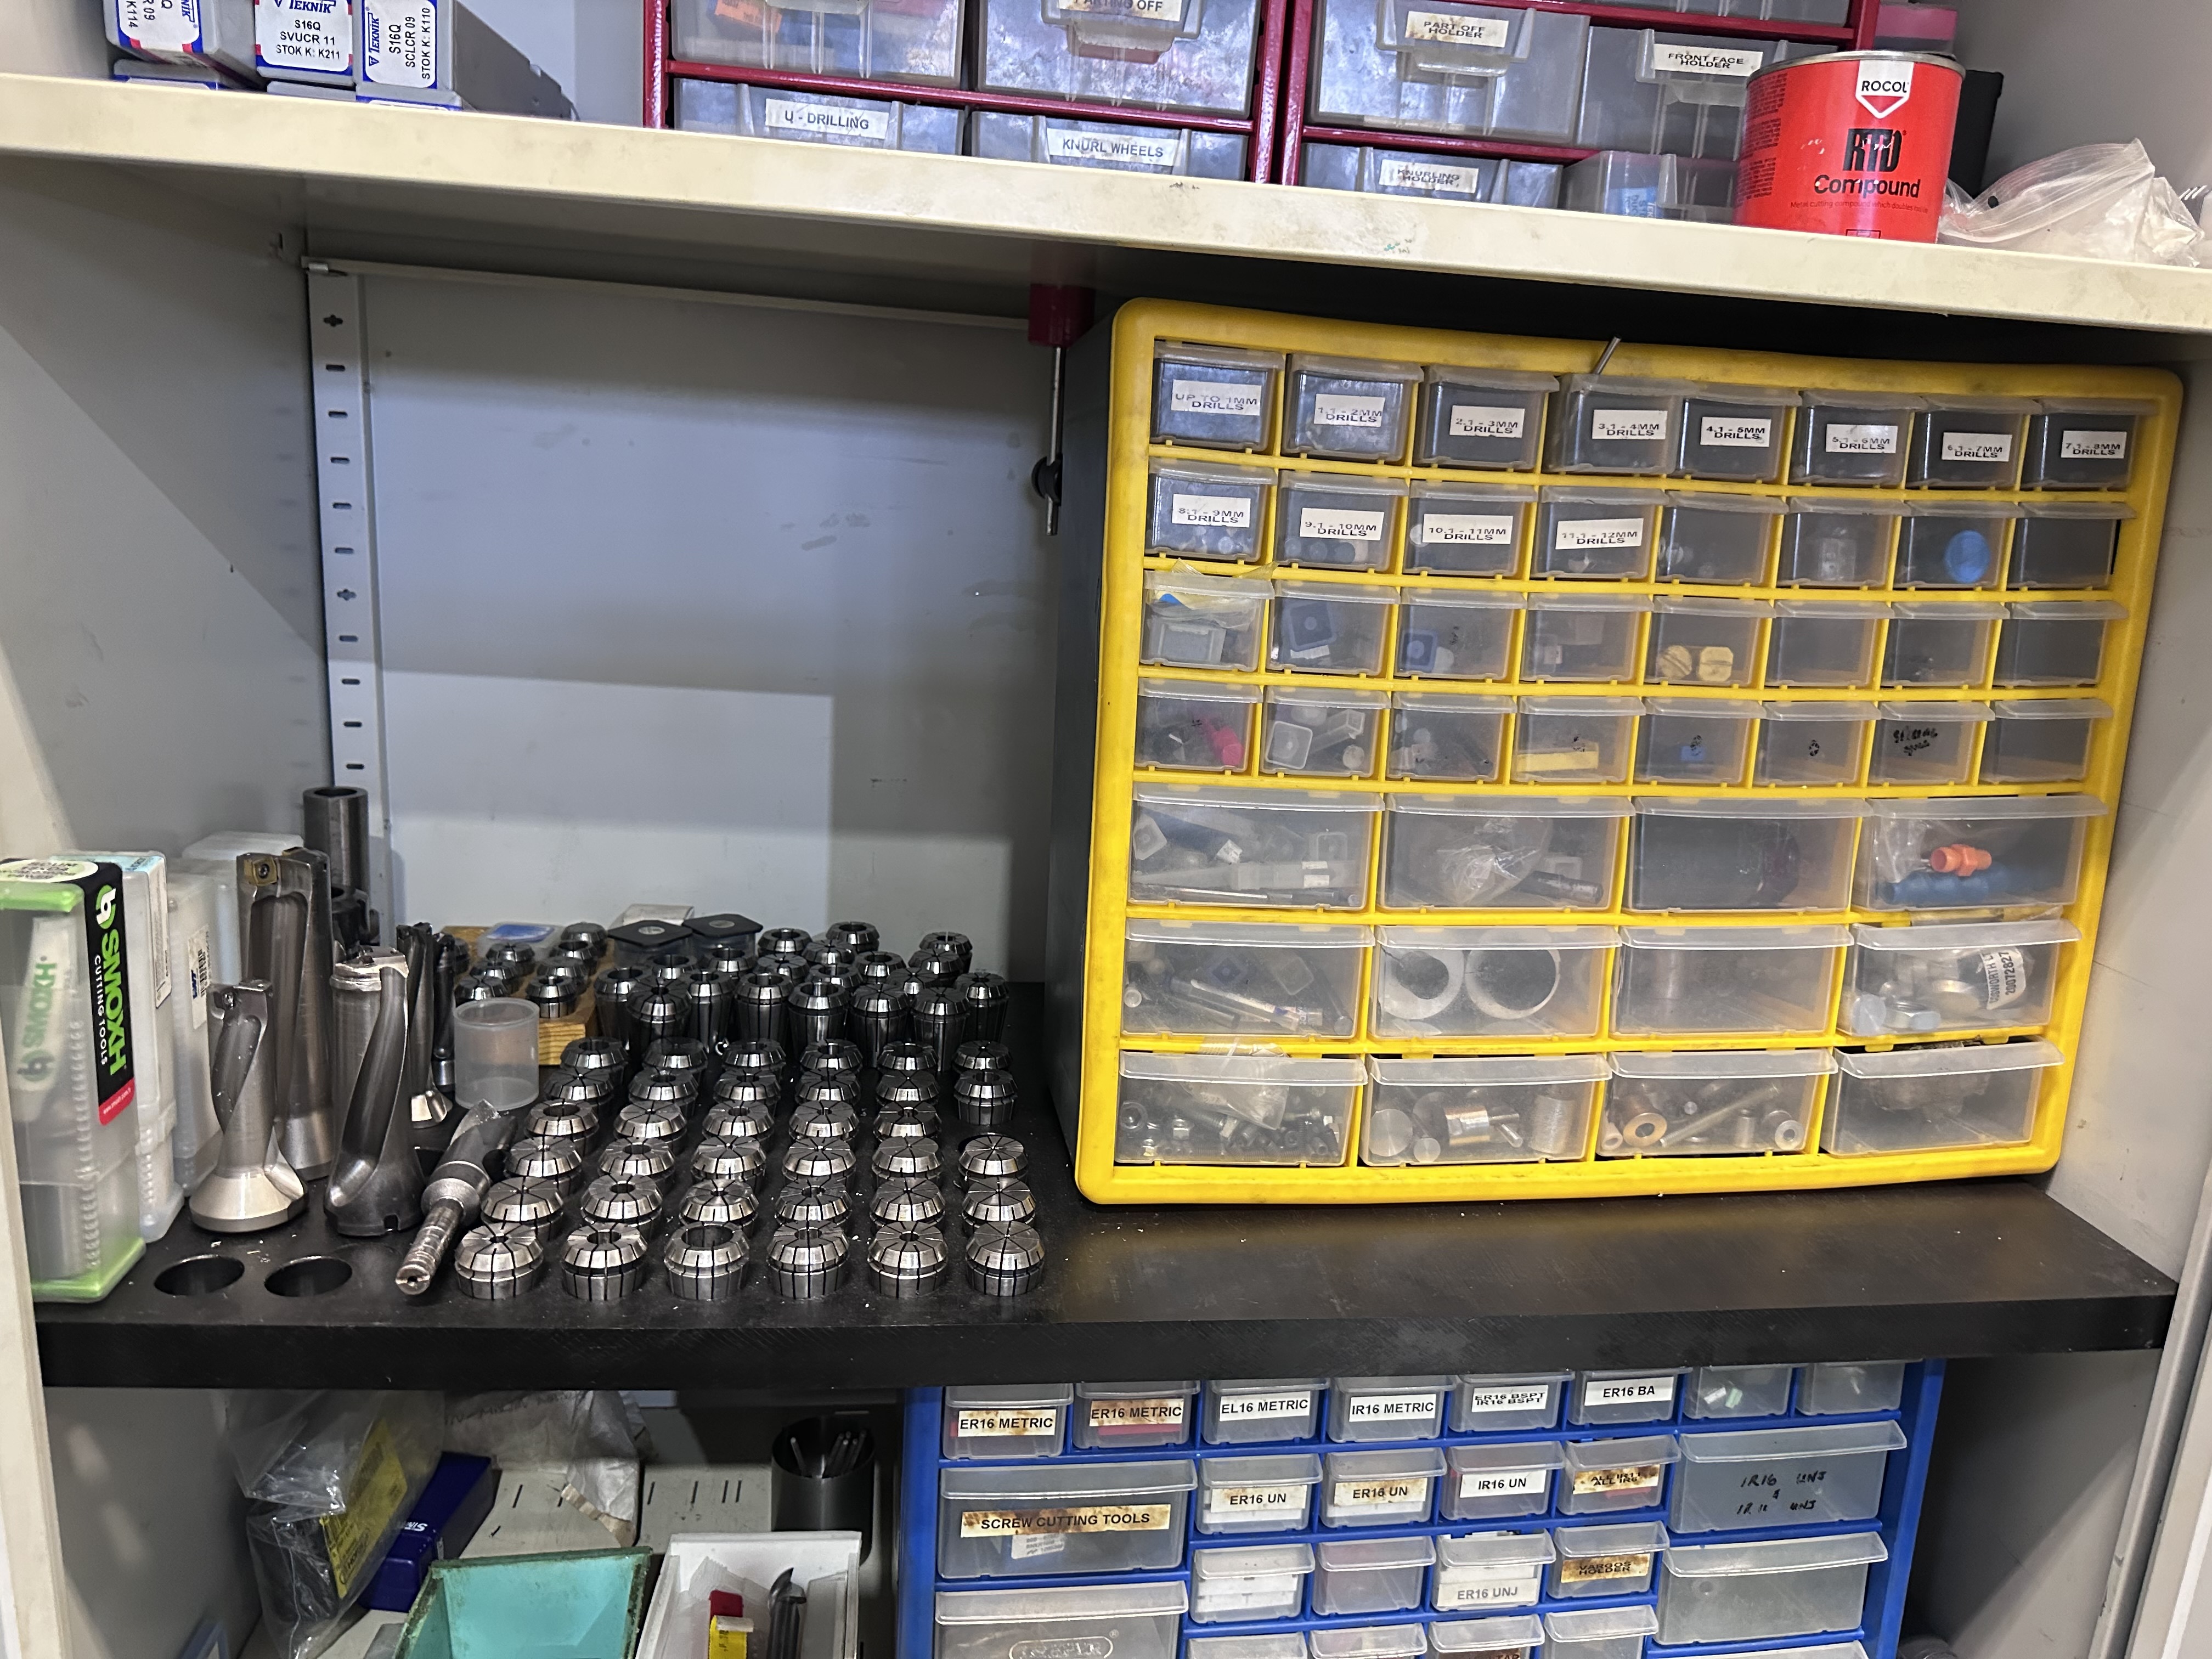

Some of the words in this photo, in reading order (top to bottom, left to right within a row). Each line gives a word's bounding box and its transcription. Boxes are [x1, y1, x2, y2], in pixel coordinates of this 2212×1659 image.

[1137, 0, 1163, 12] OFF
[144, 8, 155, 20] 09
[422, 8, 431, 33] K110
[295, 20, 321, 31] S16Q
[405, 16, 415, 29] 09
[1424, 21, 1456, 30] PART
[280, 32, 320, 44] SVUCR
[389, 24, 402, 54] S16Q
[1429, 27, 1482, 38] HOLDER
[422, 35, 431, 48] K:
[276, 45, 301, 55] STOK
[305, 48, 315, 57] K:
[318, 48, 340, 59] K211
[405, 32, 415, 67] SCLCR
[1668, 53, 1709, 61] FRONT
[422, 54, 431, 80] STOK
[1680, 60, 1730, 69] HOLDER
[1861, 80, 1908, 93] ROCOL
[808, 112, 869, 130] DRILLING
[1063, 138, 1107, 153] KNURL
[1110, 143, 1164, 158] WHEELS
[1843, 128, 1902, 172] RTD
[1402, 175, 1454, 185] HOLDER
[1814, 174, 1921, 199] Compound
[1192, 401, 1244, 410] DRILLS
[1326, 414, 1377, 422] DRILLS
[1464, 425, 1513, 434] DRILLS
[1187, 515, 1239, 523] DRILLS
[1317, 528, 1367, 537] DRILLS
[1998, 952, 2016, 995] 20072827
[94, 955, 104, 1018] CUTTING
[102, 929, 127, 1076] SMOXH
[98, 1021, 109, 1066] TOOLS
[1603, 1387, 1634, 1398] ER16
[1637, 1385, 1655, 1396] BA
[1091, 1407, 1126, 1419] ER16
[1130, 1406, 1182, 1419] METRIC
[1221, 1401, 1255, 1414] EL16
[1257, 1399, 1308, 1412] METRIC
[1352, 1404, 1381, 1415] IR16
[1384, 1402, 1434, 1414] METRIC
[960, 1417, 995, 1430] ER16
[998, 1417, 1053, 1430] METRIC
[1479, 1480, 1505, 1489] IR16
[1509, 1478, 1526, 1487] UN
[1229, 1493, 1263, 1505] ER16
[1267, 1493, 1287, 1504] UN
[1352, 1487, 1385, 1499] ER16
[1389, 1486, 1408, 1496] UN
[981, 1515, 1032, 1529] SCREW
[1036, 1514, 1098, 1528] CUTTING
[1102, 1513, 1150, 1525] TOOLS
[1579, 1566, 1631, 1575] HOLDER
[1457, 1588, 1488, 1600] ER16
[1492, 1587, 1518, 1598] UNJ
